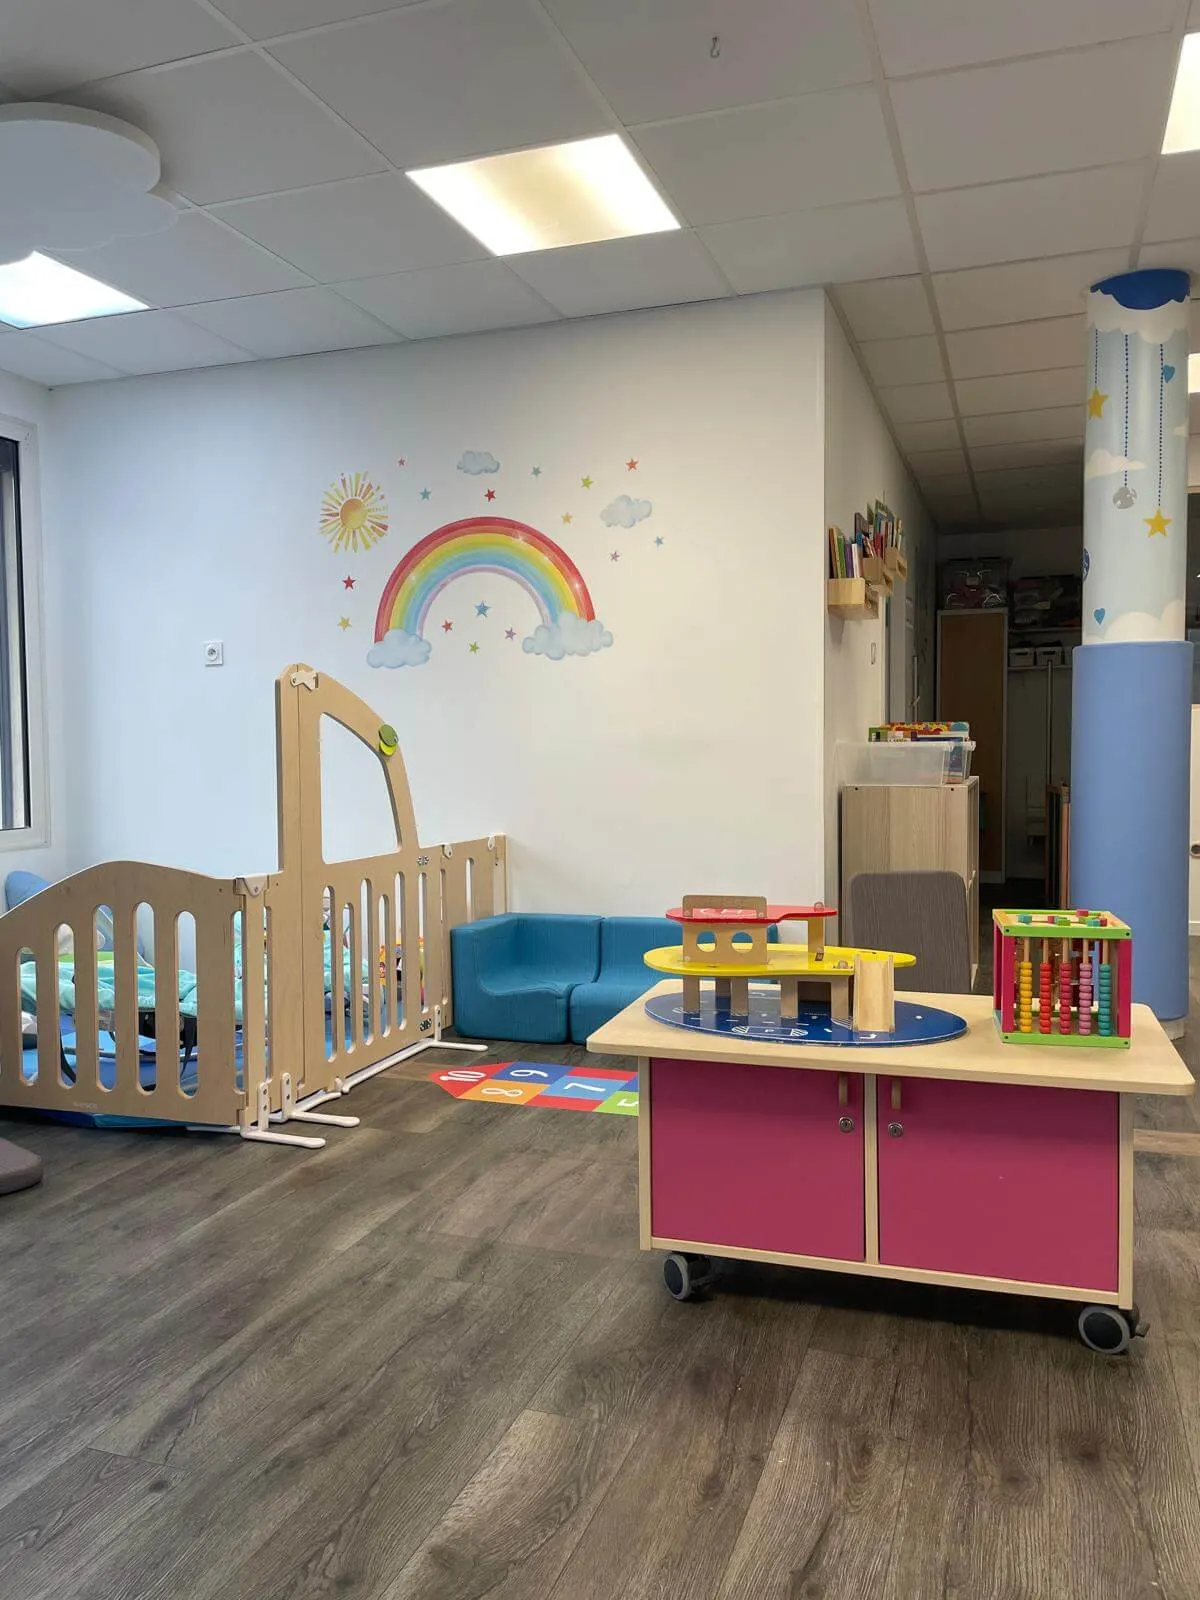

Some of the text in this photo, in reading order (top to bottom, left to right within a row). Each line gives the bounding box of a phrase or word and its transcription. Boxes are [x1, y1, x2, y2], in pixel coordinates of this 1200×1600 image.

[439, 1070, 486, 1081] 10
[509, 1069, 549, 1077] 9
[564, 1082, 607, 1092] 7
[481, 1087, 523, 1098] 8
